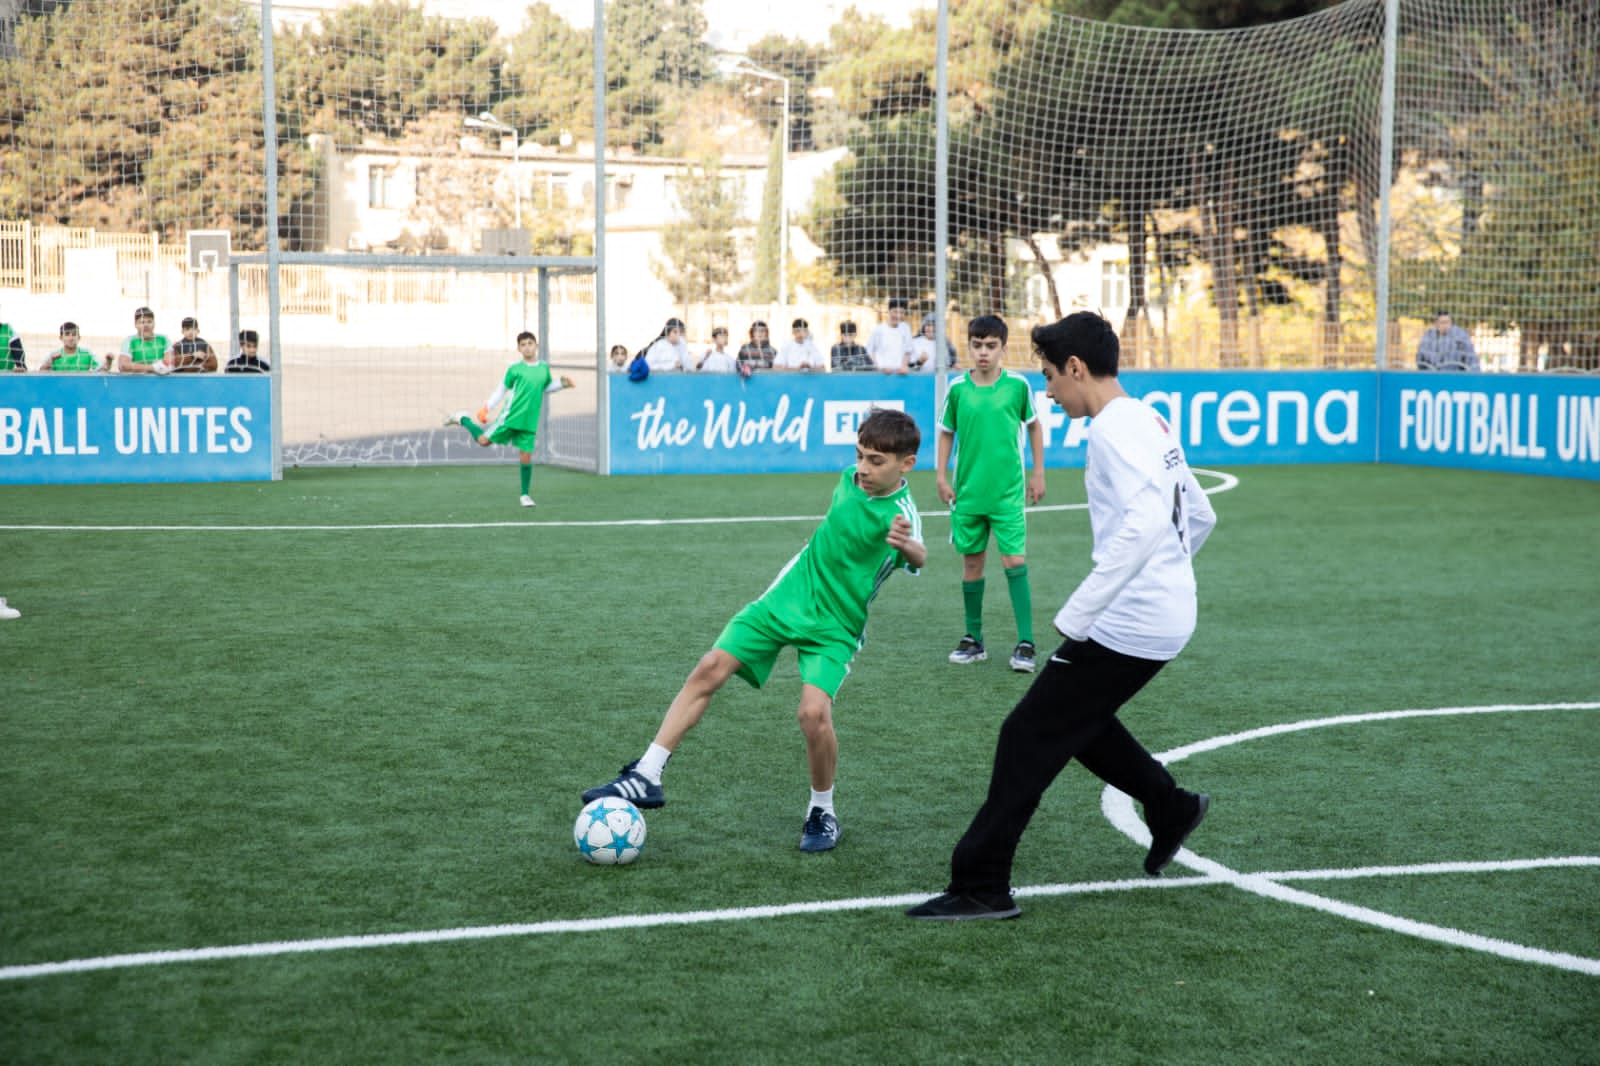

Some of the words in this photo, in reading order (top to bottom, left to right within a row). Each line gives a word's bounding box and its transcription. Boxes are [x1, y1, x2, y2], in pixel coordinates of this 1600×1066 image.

[0, 407, 99, 456] BALL
[114, 406, 253, 455] UNITES
[630, 396, 697, 451] the
[703, 394, 814, 452] World
[1140, 390, 1359, 447] arena
[1400, 389, 1546, 460] FOOTBALL
[1557, 395, 1600, 462] UN
